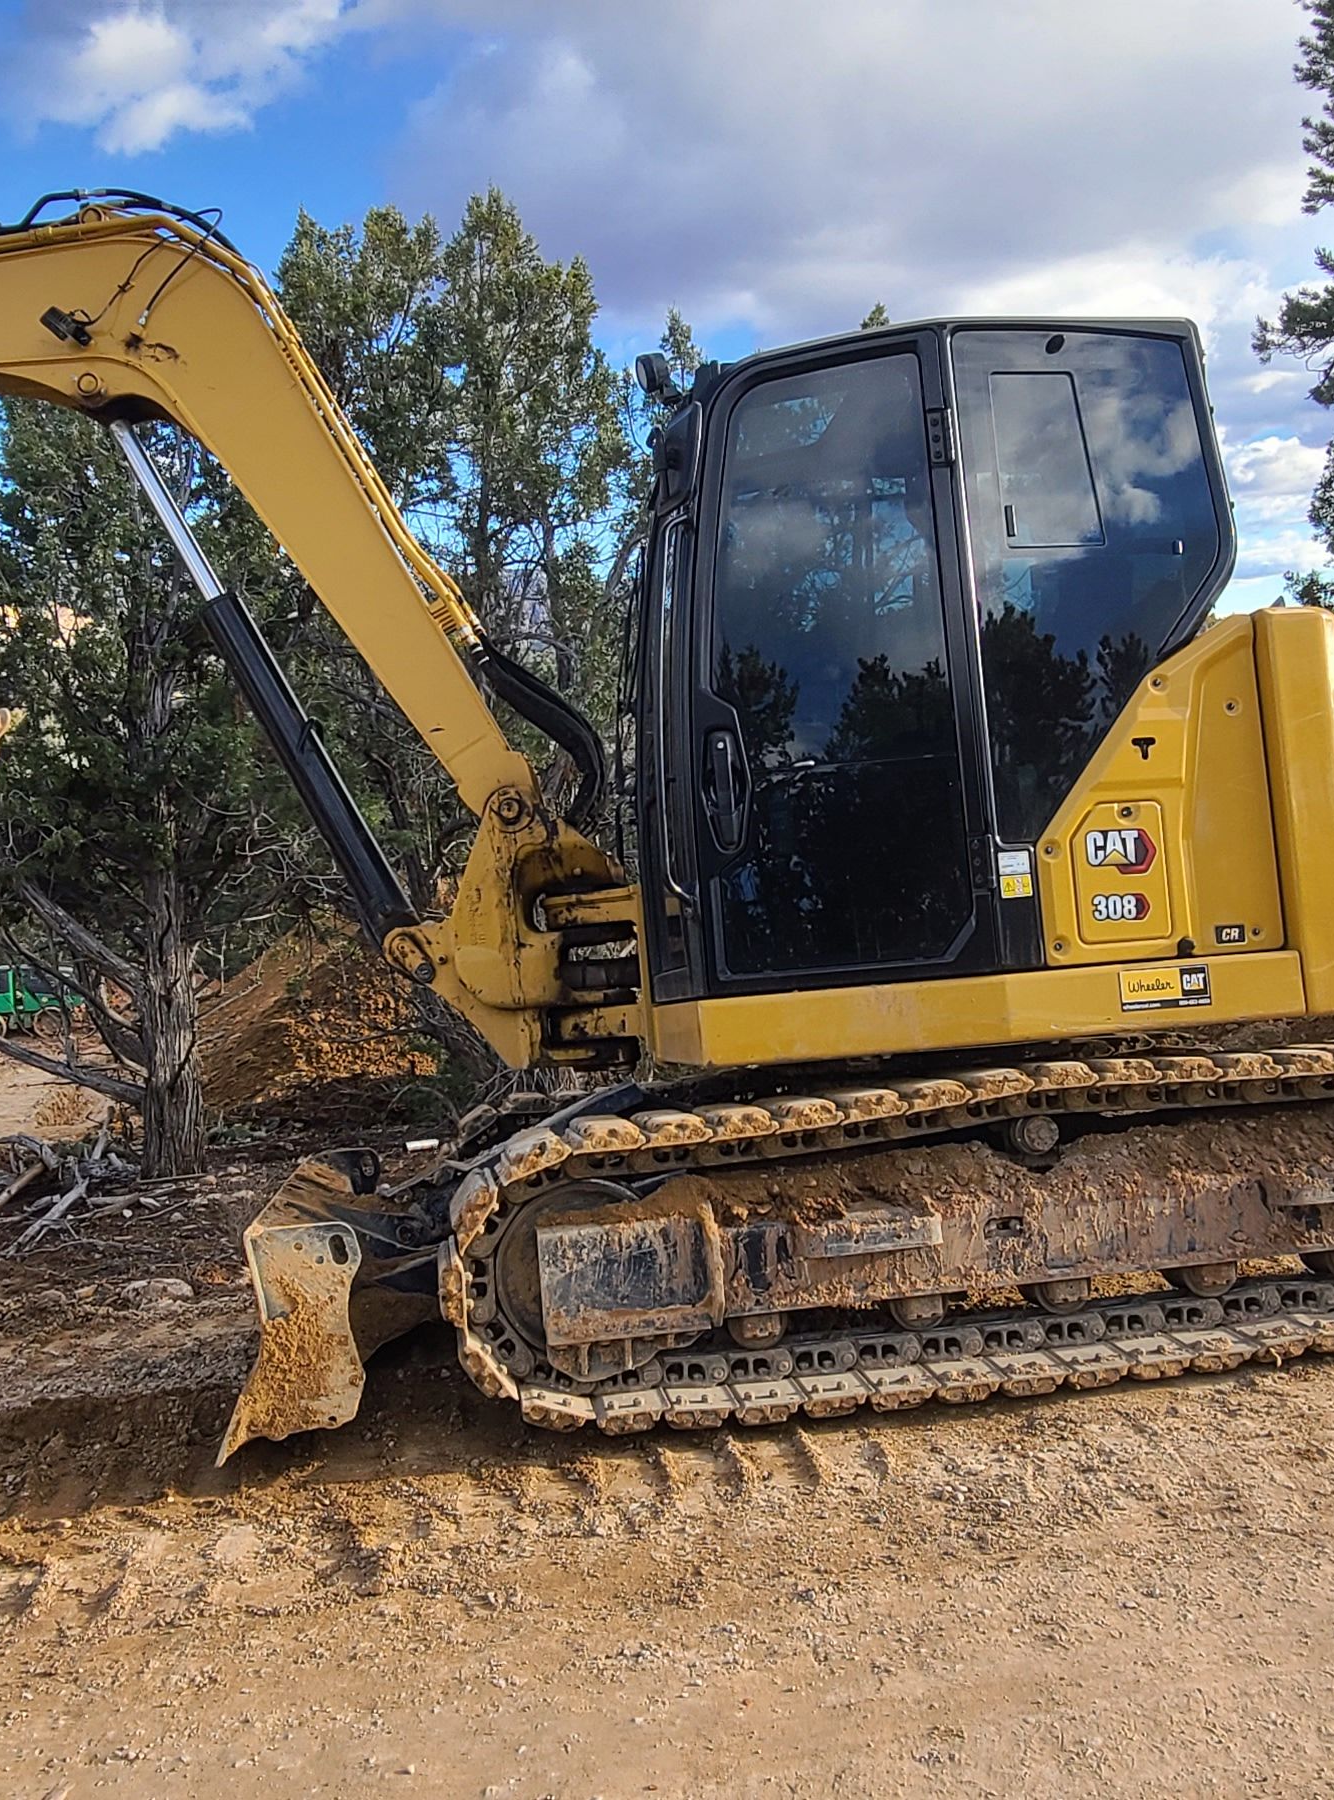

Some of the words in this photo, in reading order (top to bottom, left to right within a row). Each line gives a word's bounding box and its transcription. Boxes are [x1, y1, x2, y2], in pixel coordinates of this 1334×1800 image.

[1086, 830, 1139, 866] CAT
[1092, 894, 1137, 921] 308
[1221, 927, 1240, 941] CR
[1127, 978, 1175, 993] Wheeler
[1182, 972, 1205, 991] CAT
